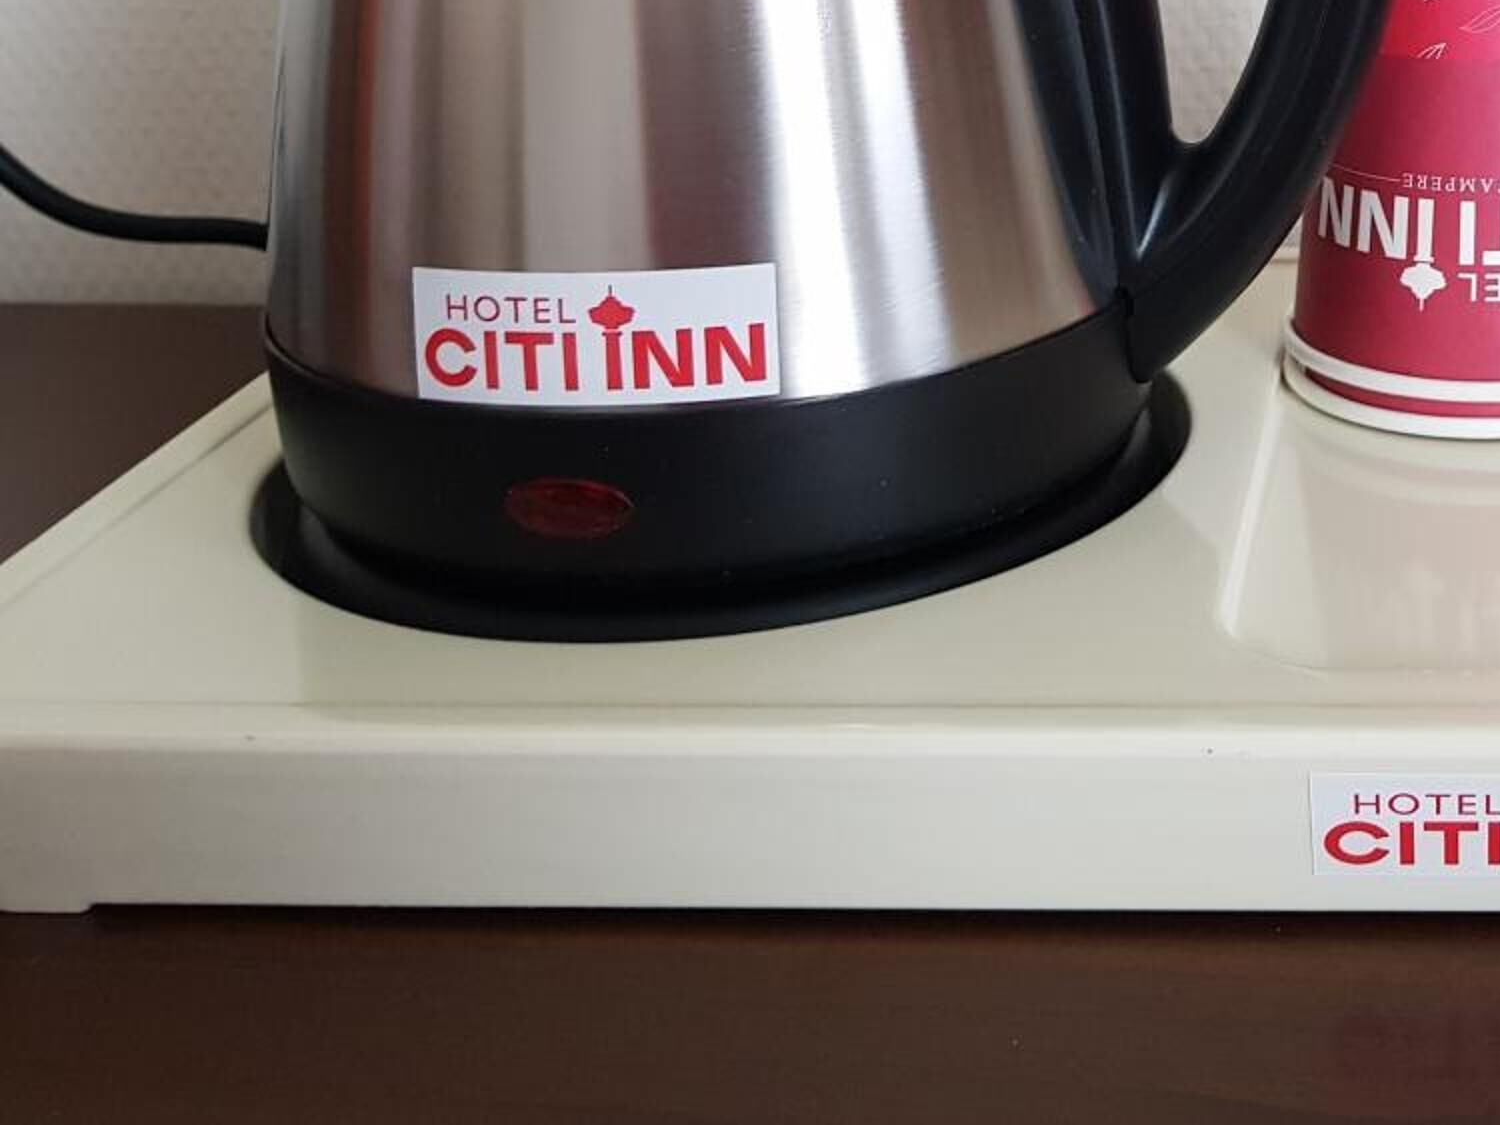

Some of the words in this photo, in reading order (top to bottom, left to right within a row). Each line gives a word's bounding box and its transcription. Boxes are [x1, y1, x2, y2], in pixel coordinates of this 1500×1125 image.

[1318, 176, 1435, 263] INN
[444, 293, 577, 324] HOTEL
[424, 327, 580, 392] CITI
[601, 322, 768, 392] INN
